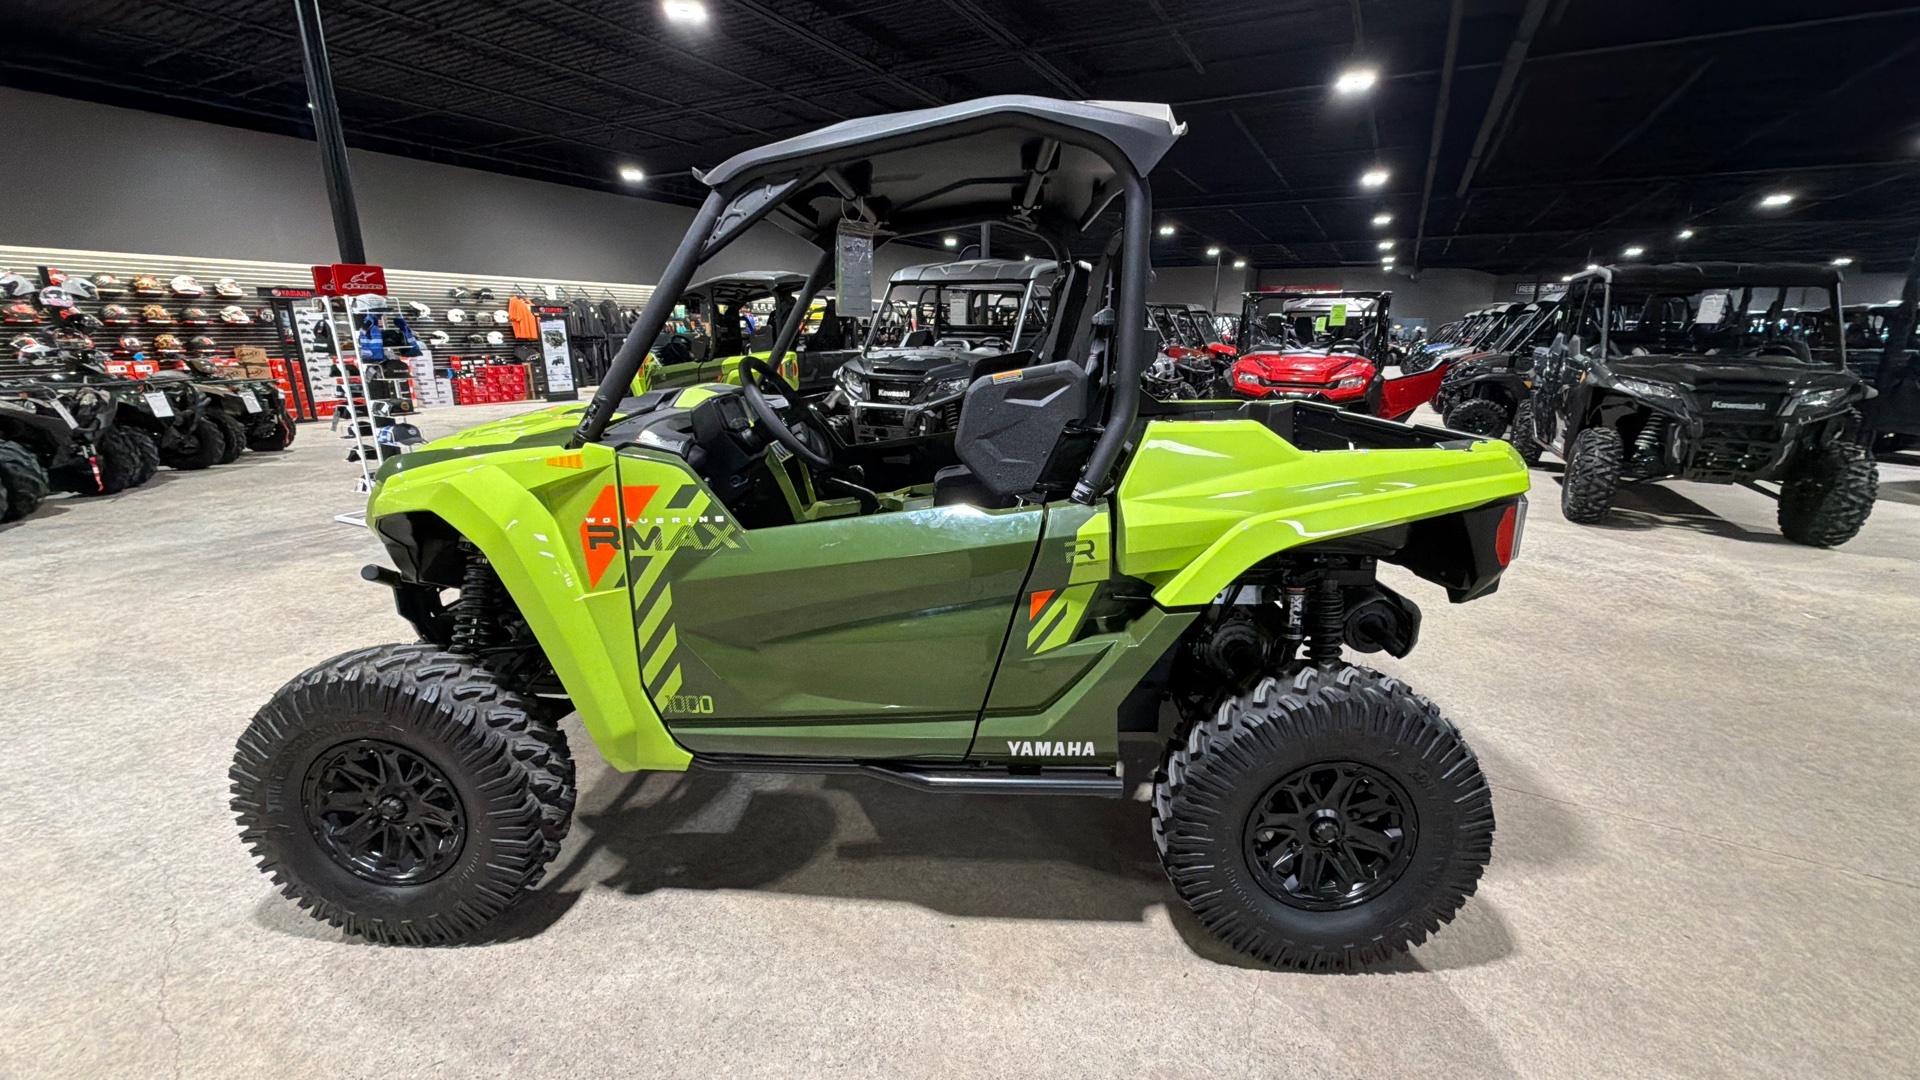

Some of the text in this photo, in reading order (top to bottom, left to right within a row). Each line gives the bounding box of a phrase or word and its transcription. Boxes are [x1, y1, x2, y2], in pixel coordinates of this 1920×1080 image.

[878, 389, 910, 397] Kawasaki
[1711, 401, 1766, 410] Kawasaki
[587, 525, 740, 551] RMAX
[665, 695, 714, 713] 1000
[1007, 741, 1095, 756] YAMAHA
